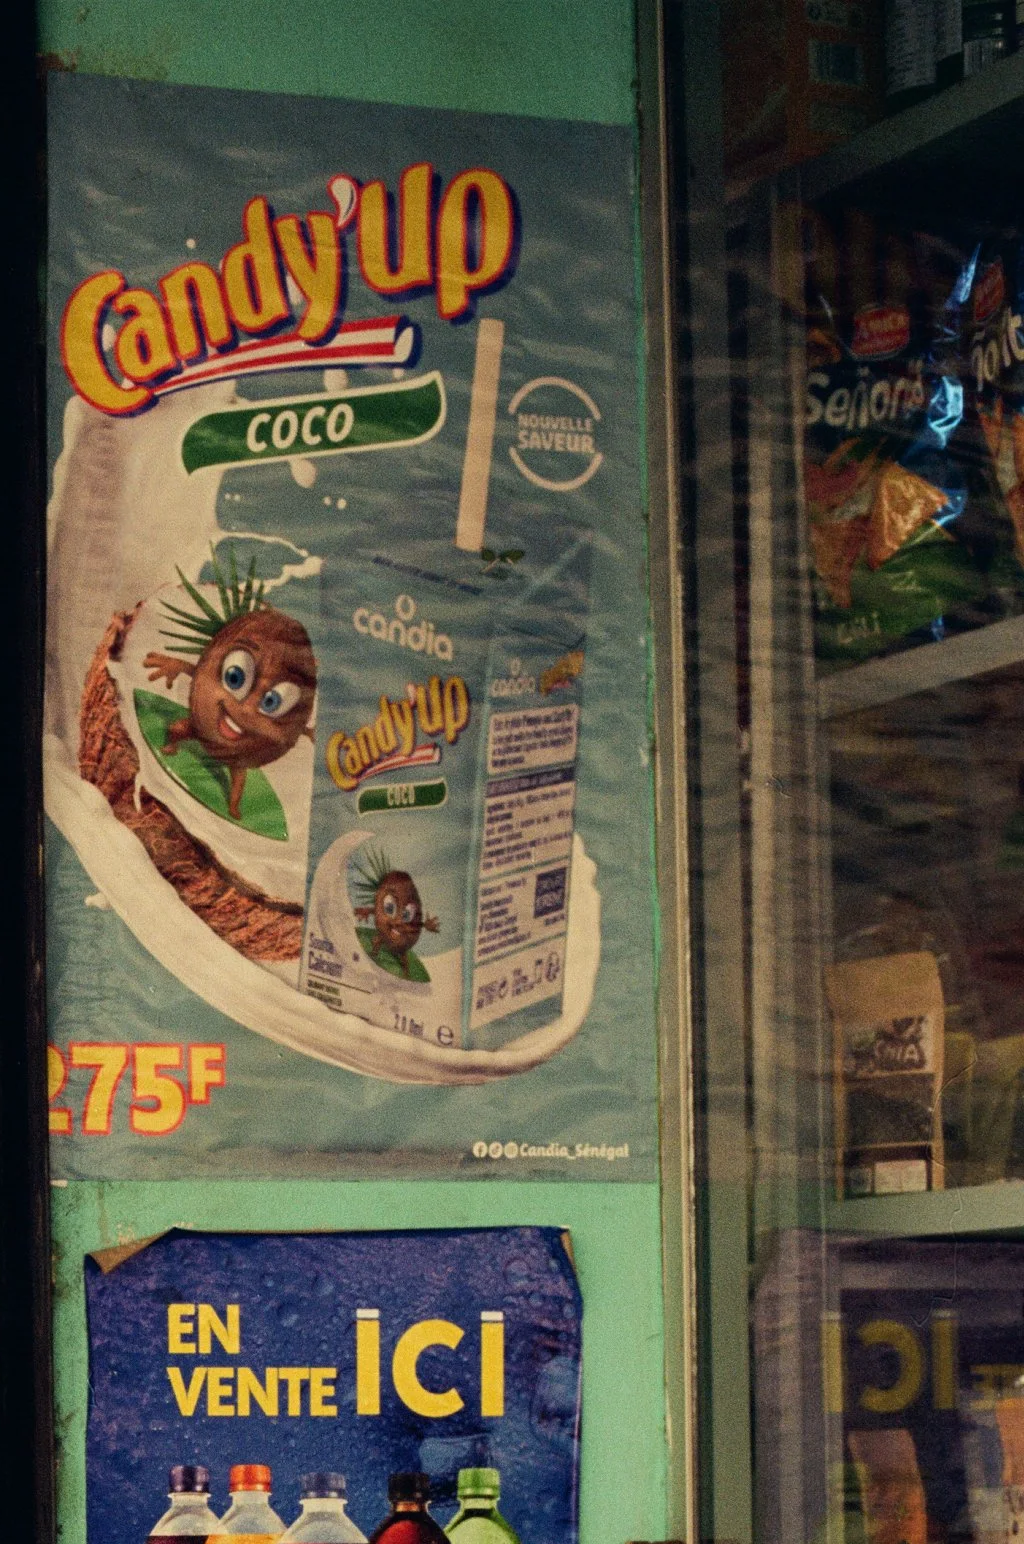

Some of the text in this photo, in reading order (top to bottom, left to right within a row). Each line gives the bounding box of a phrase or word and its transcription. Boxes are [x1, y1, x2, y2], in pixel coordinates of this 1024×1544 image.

[245, 403, 354, 453] COCO
[517, 413, 594, 433] NOUVELLE
[517, 430, 596, 454] SAVEUR
[352, 607, 454, 662] candia
[167, 1303, 240, 1355] EN
[167, 1309, 505, 1418] VENTE ICI
